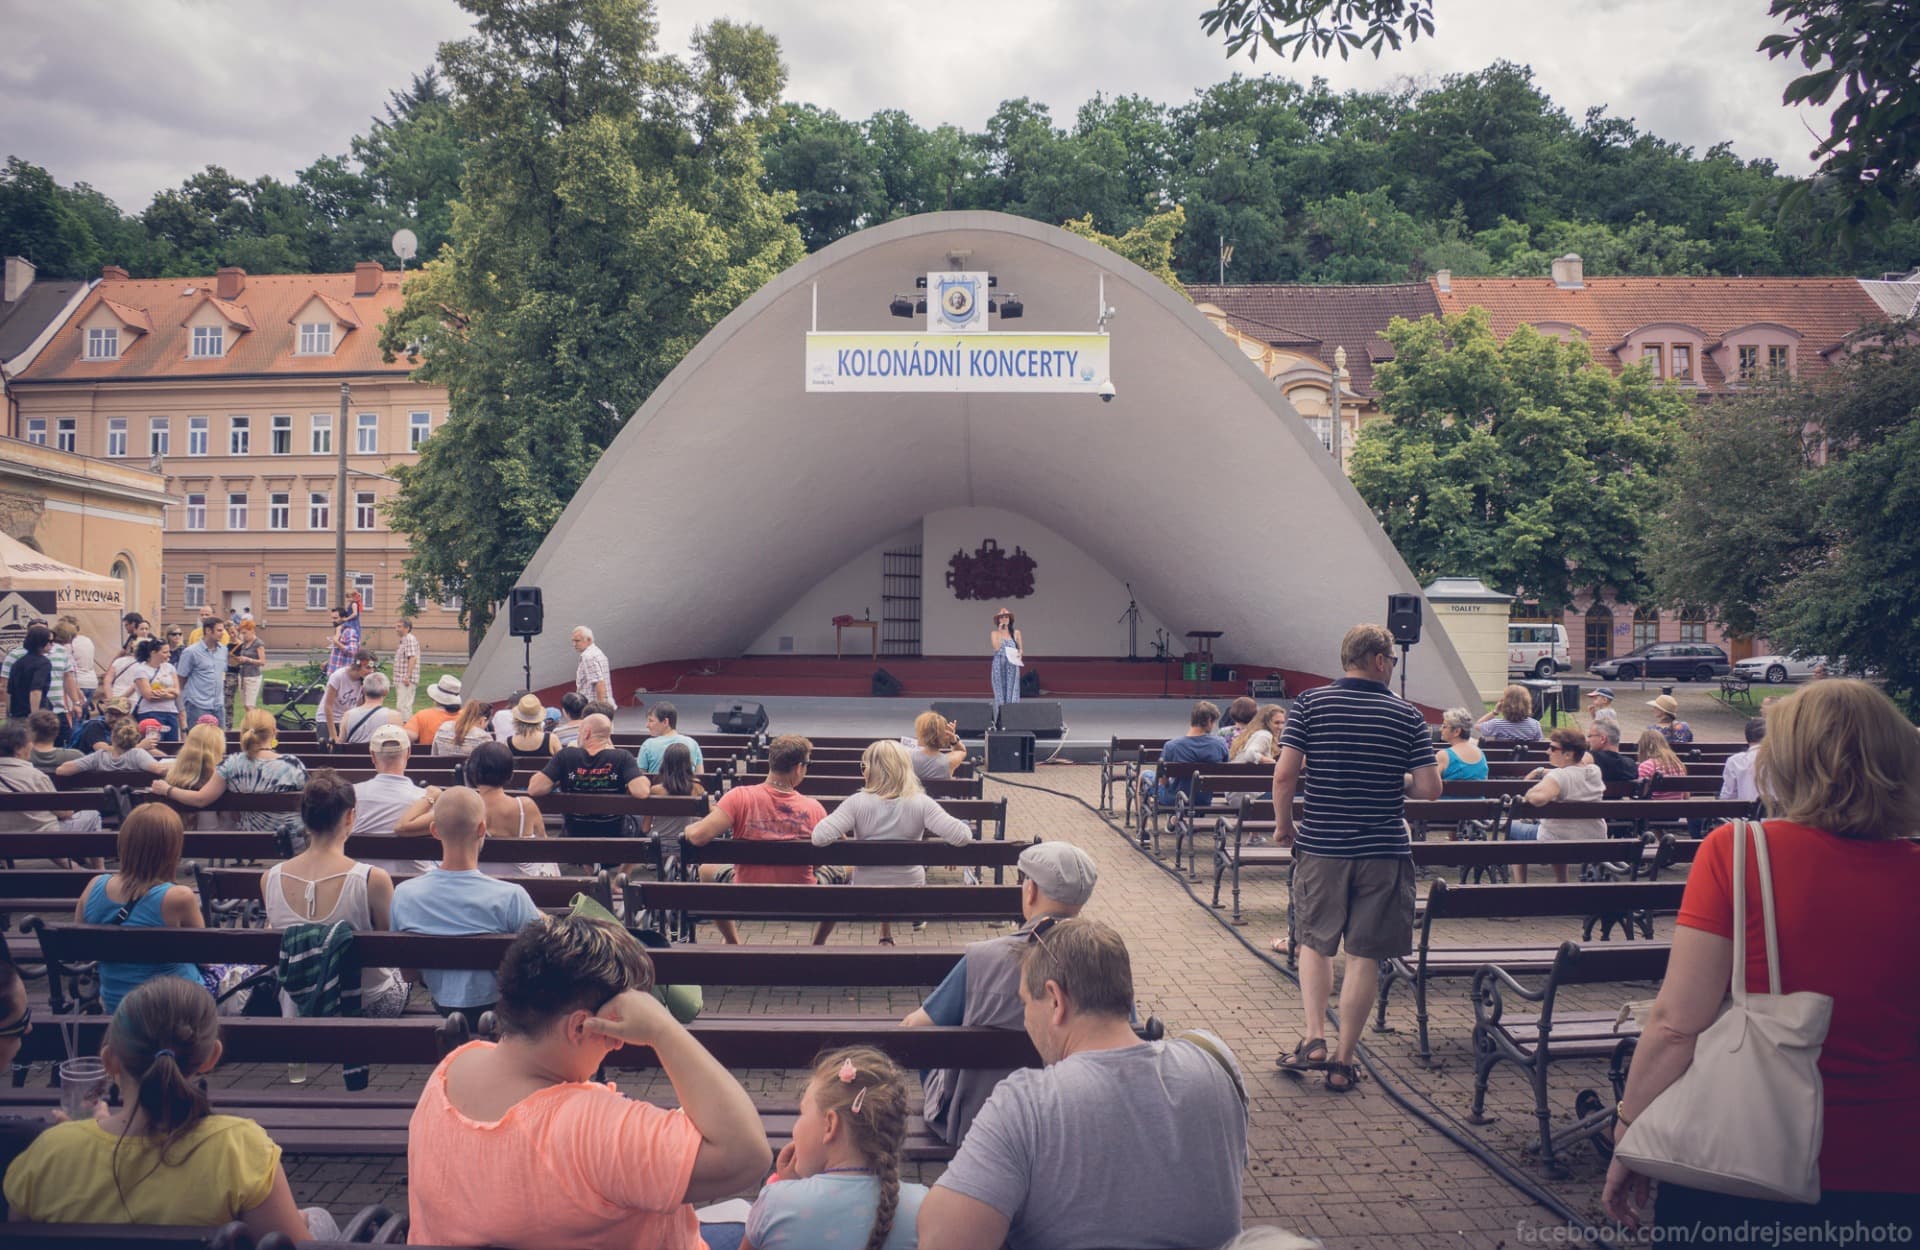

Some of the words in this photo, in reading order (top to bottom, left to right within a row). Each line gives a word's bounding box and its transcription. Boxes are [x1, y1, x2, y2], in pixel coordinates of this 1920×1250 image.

[837, 341, 962, 377] KOLONÁDNÍ
[969, 349, 1078, 377] KONCERTY
[74, 588, 120, 603] PIVOVAR
[1450, 604, 1481, 612] TOALETY
